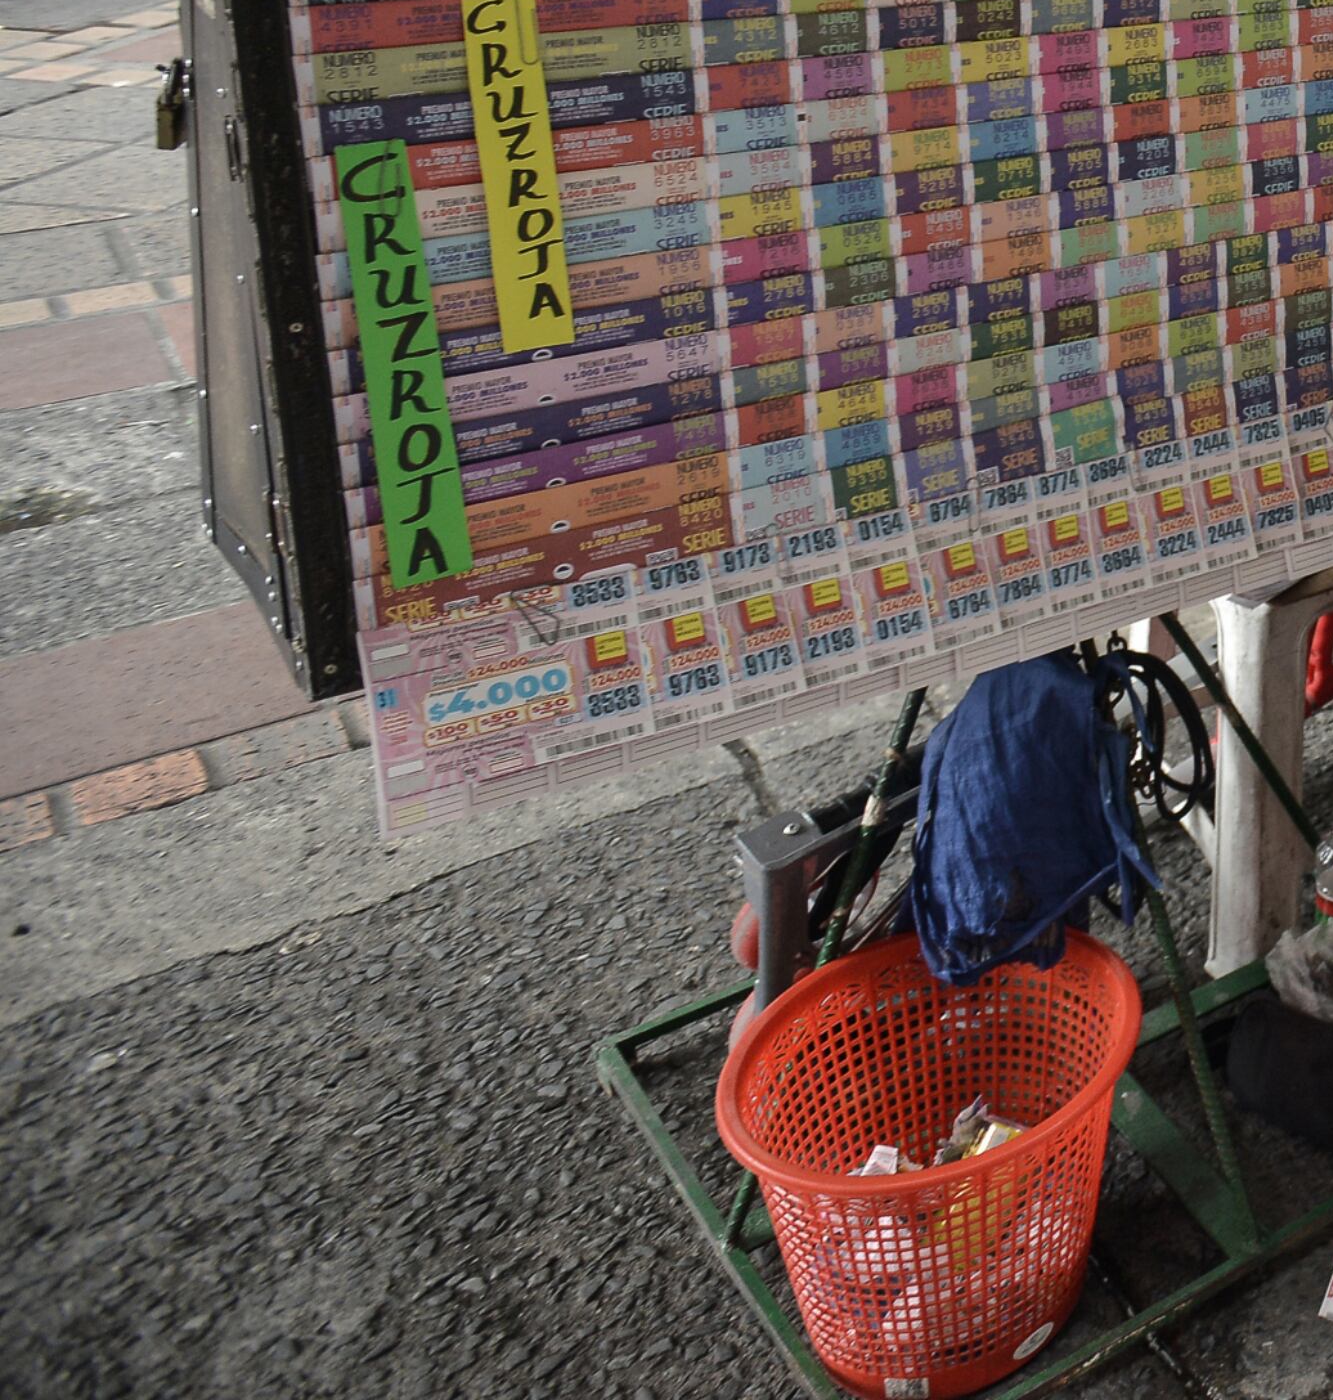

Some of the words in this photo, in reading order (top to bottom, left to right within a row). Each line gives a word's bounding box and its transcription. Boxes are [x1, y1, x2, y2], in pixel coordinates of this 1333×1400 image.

[332, 118, 386, 134] 1543
[774, 505, 816, 528] SERIE
[682, 527, 728, 553] SERIE
[790, 527, 837, 558] 2193
[724, 542, 771, 573] 9173
[745, 644, 793, 676] 9173
[427, 668, 568, 724] $4.000
[669, 664, 721, 697] 9763
